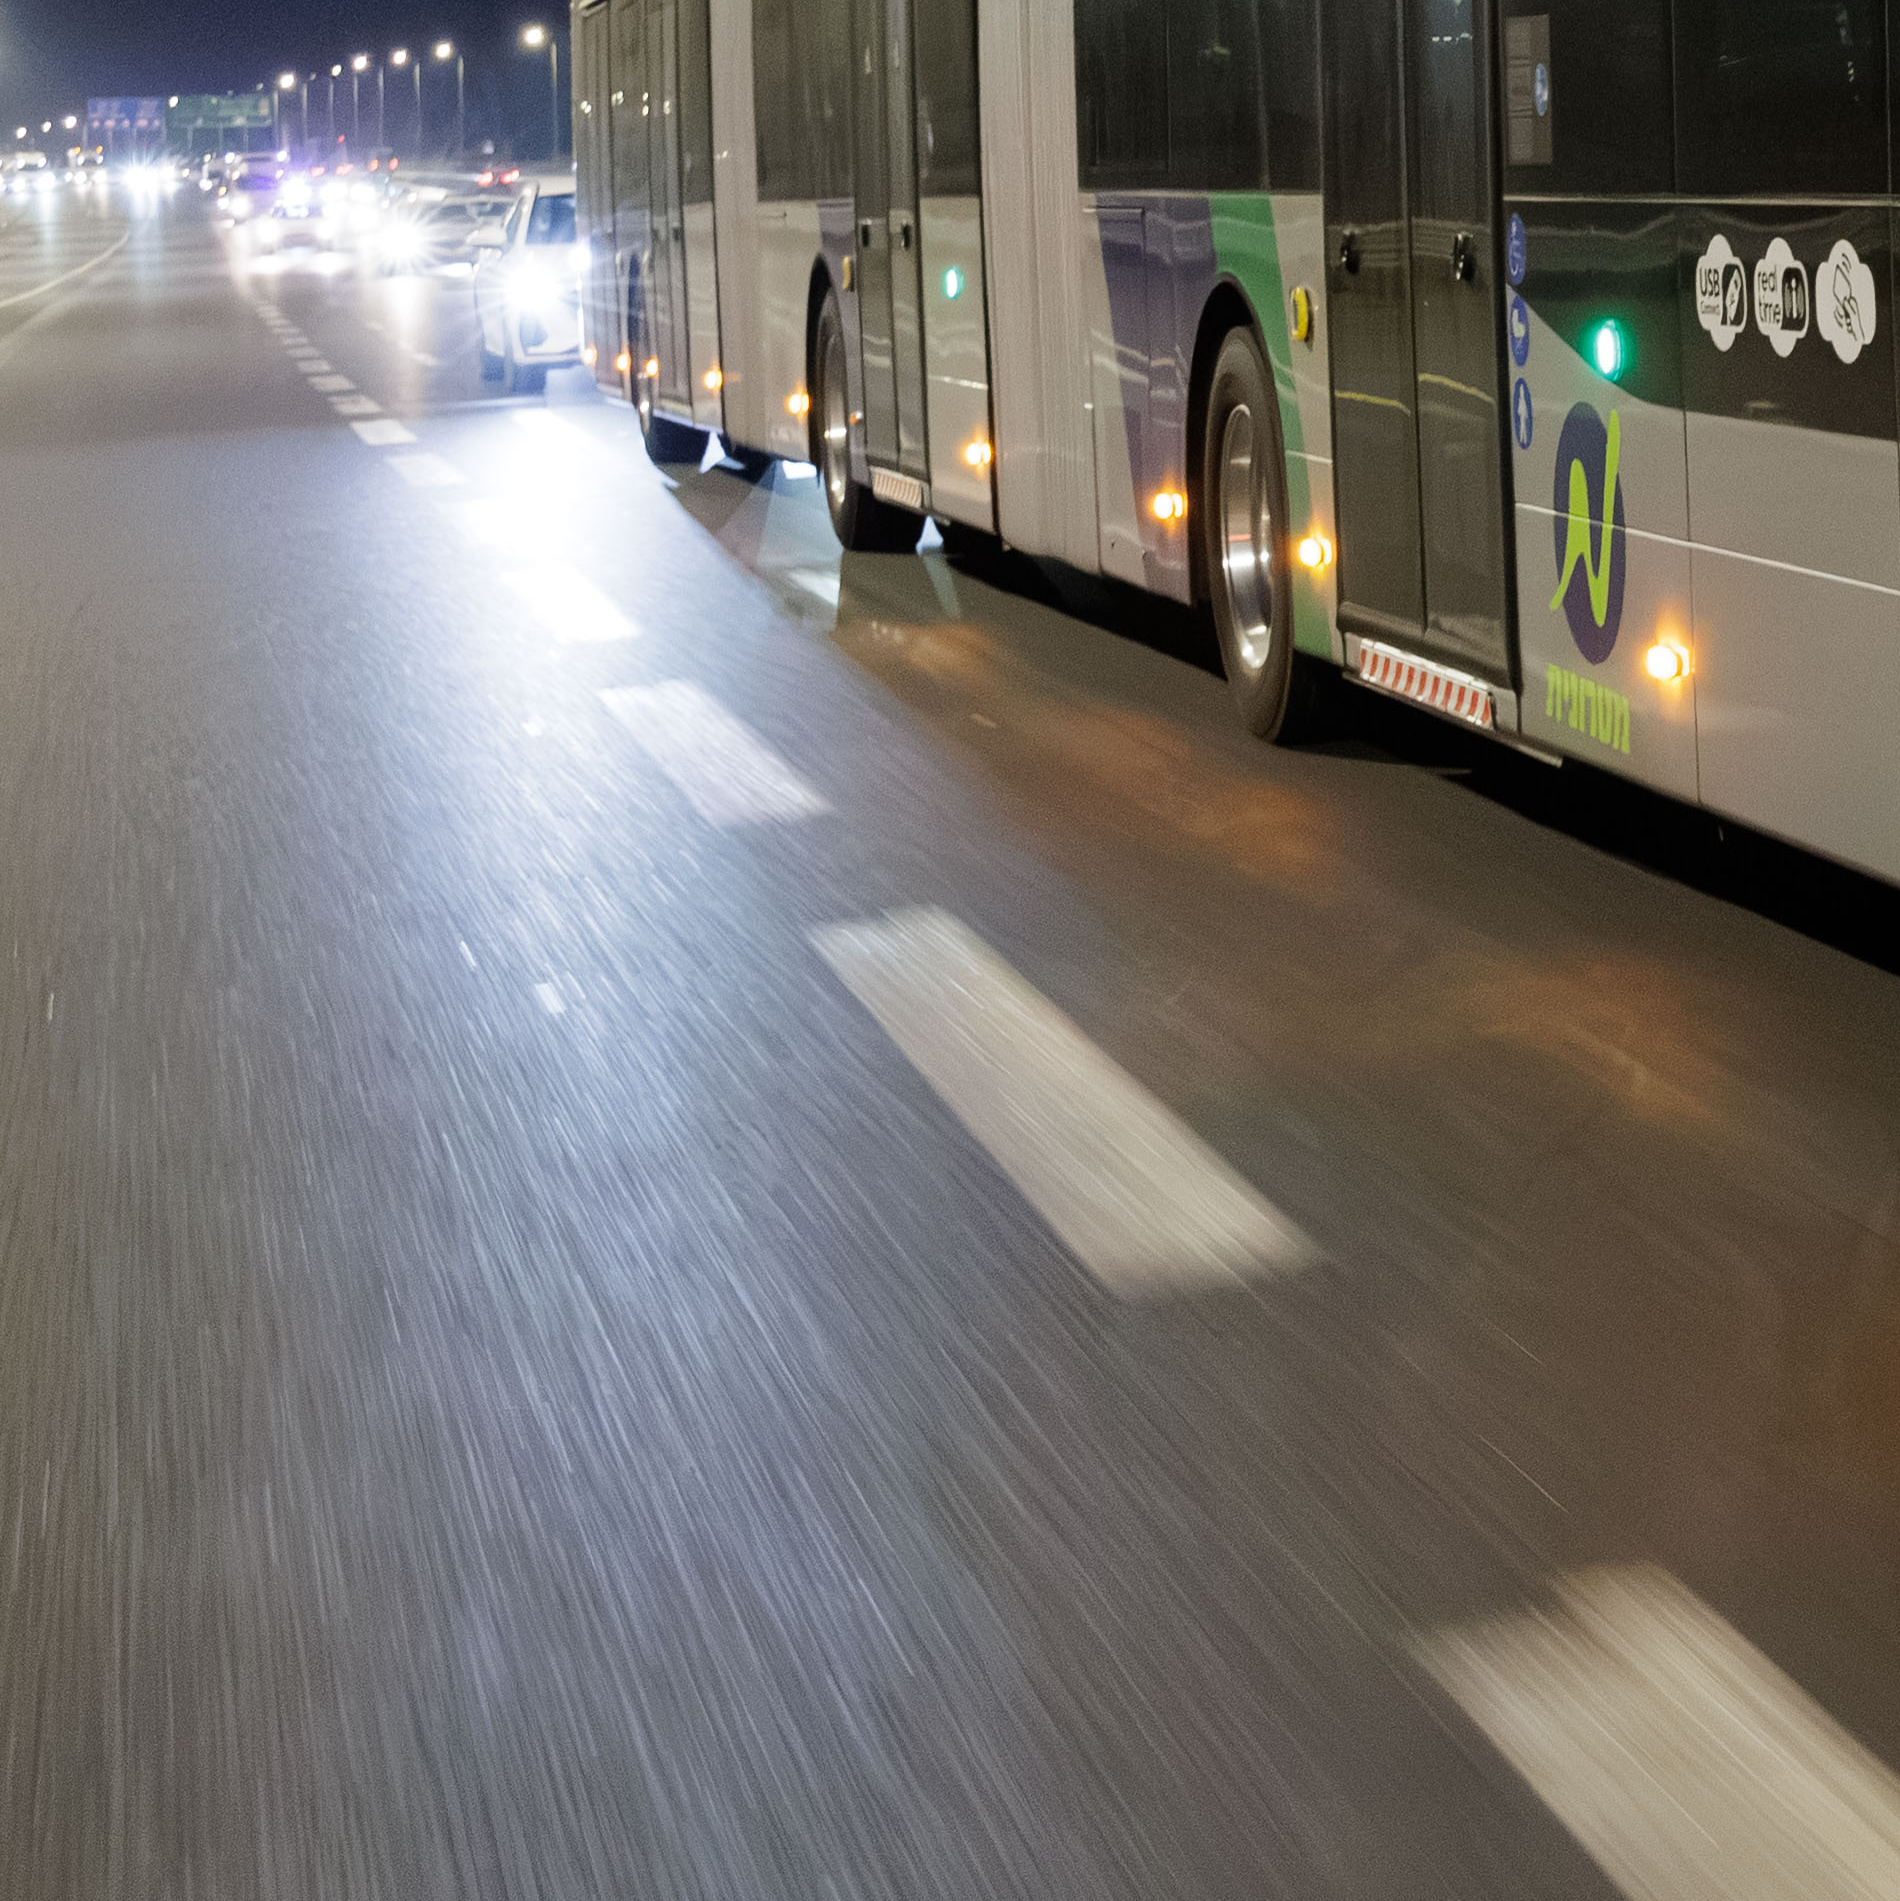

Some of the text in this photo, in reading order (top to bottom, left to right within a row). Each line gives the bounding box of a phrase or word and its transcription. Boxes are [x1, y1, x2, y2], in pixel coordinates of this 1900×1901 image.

[1699, 267, 1721, 297] USB
[1758, 294, 1781, 324] time
[1546, 663, 1630, 754] מטרונית
